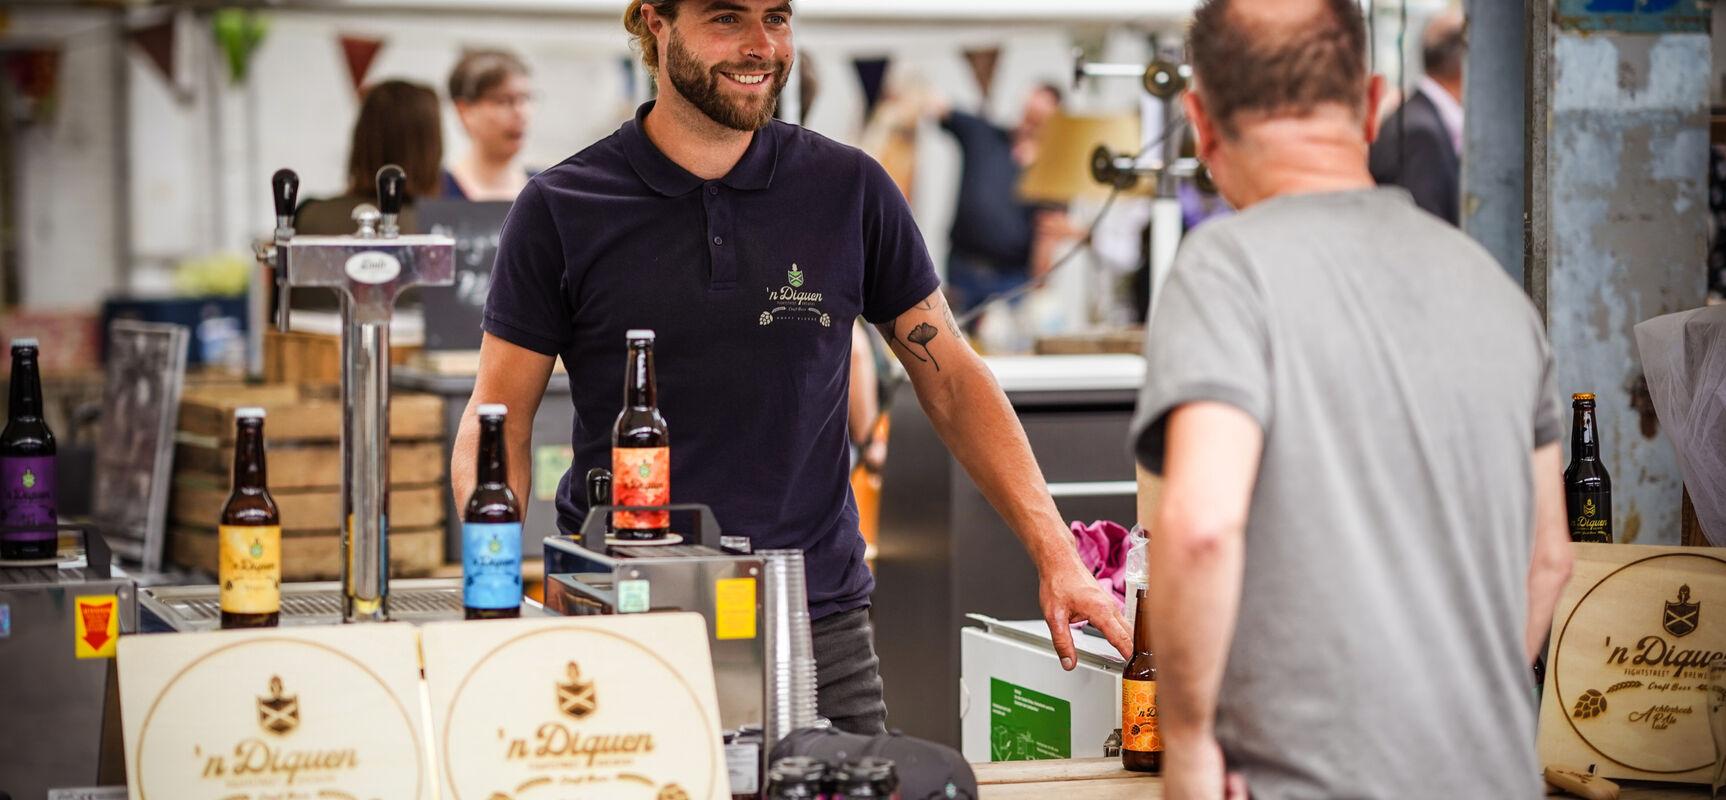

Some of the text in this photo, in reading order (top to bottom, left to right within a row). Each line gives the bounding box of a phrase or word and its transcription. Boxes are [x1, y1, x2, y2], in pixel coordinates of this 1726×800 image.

[766, 286, 823, 305] 'n Diquen
[1577, 516, 1608, 530] Diquen
[1605, 636, 1629, 664] 'n
[1624, 668, 1670, 678] FIGHTSTREET
[1647, 682, 1691, 691] Craft Beer
[498, 722, 655, 767] 'n Diquen
[194, 737, 356, 786] 'n Diquen
